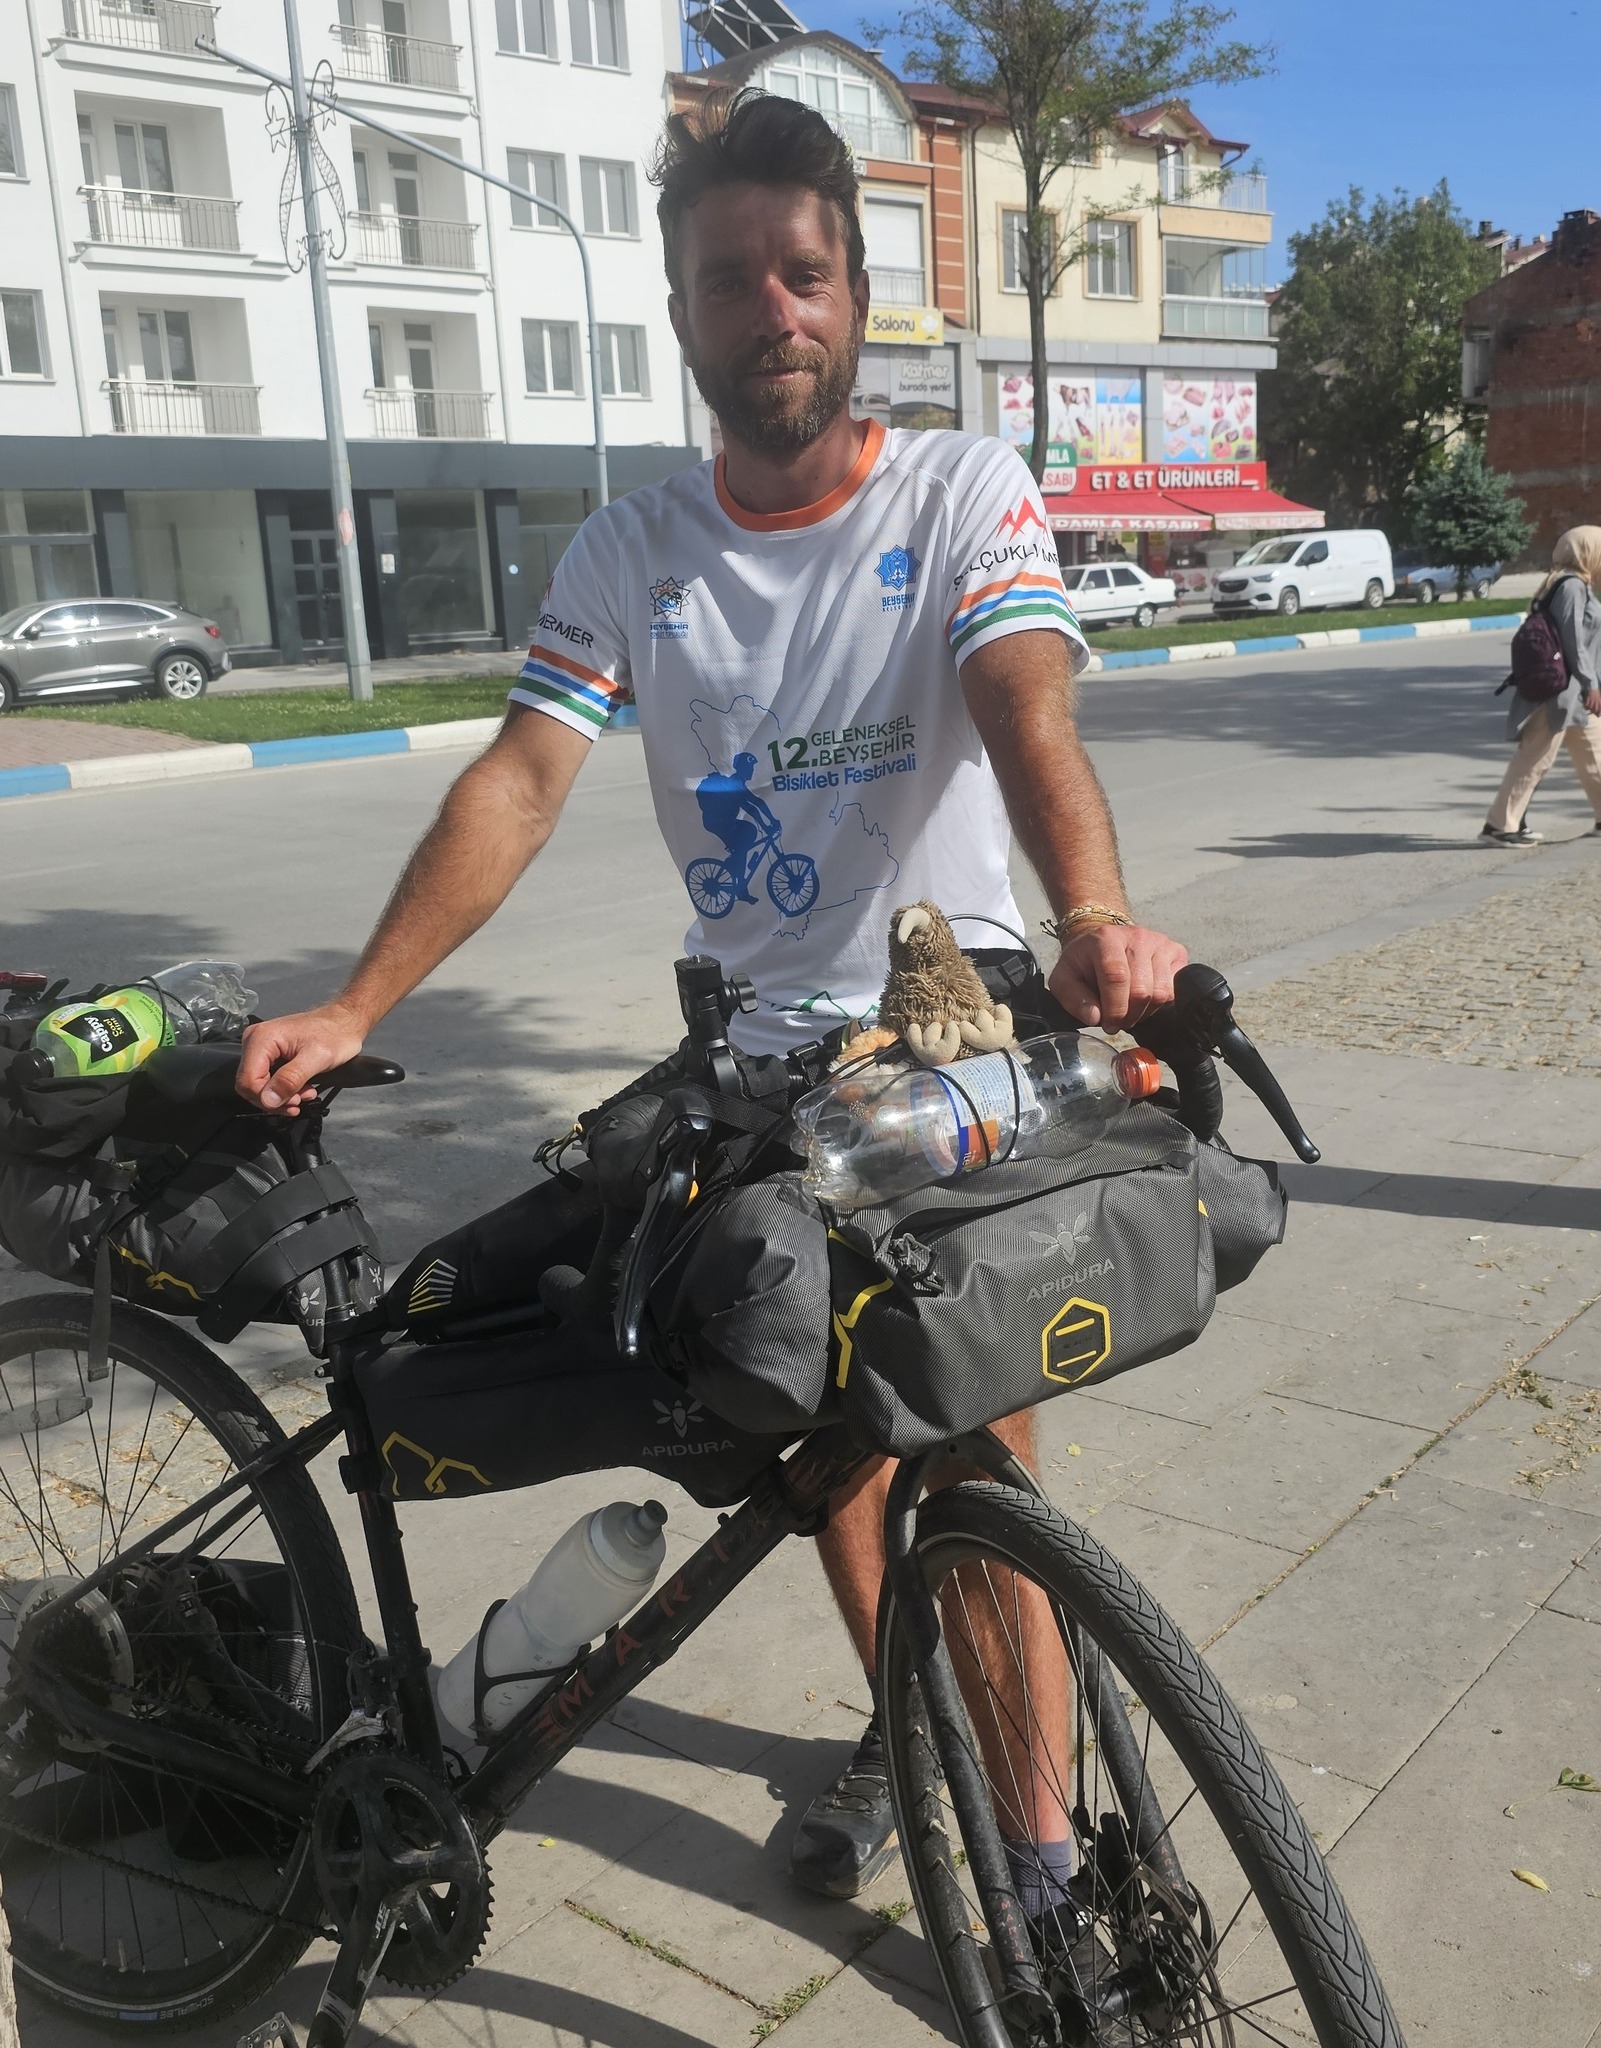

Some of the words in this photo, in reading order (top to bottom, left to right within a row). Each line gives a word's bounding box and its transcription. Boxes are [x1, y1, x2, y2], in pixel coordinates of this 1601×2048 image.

[872, 314, 915, 332] Salonu
[901, 360, 950, 380] Katmer
[898, 381, 928, 392] burada
[1046, 448, 1071, 464] MLA
[1041, 472, 1073, 487] SABI
[1091, 470, 1113, 490] ET
[1116, 470, 1130, 490] &
[1133, 470, 1155, 490] ET
[1157, 465, 1240, 489] ÜRÜNLERİ
[1055, 518, 1123, 530] DAMLA
[1127, 519, 1200, 531] KASABI
[767, 737, 818, 772] 12.
[811, 714, 916, 746] GELENEKSEL
[819, 732, 916, 767] BEYŞEHİR
[772, 771, 839, 792] Bisiklet
[844, 753, 917, 785] Festivali
[84, 1016, 113, 1052] Cappy
[103, 1018, 120, 1037] Cool
[110, 1016, 125, 1035] Mint
[1025, 1258, 1115, 1301] APIDURA
[641, 1439, 736, 1457] APIDURA
[557, 1503, 768, 1718] MARI
[1001, 1900, 1025, 1961] MARIN
